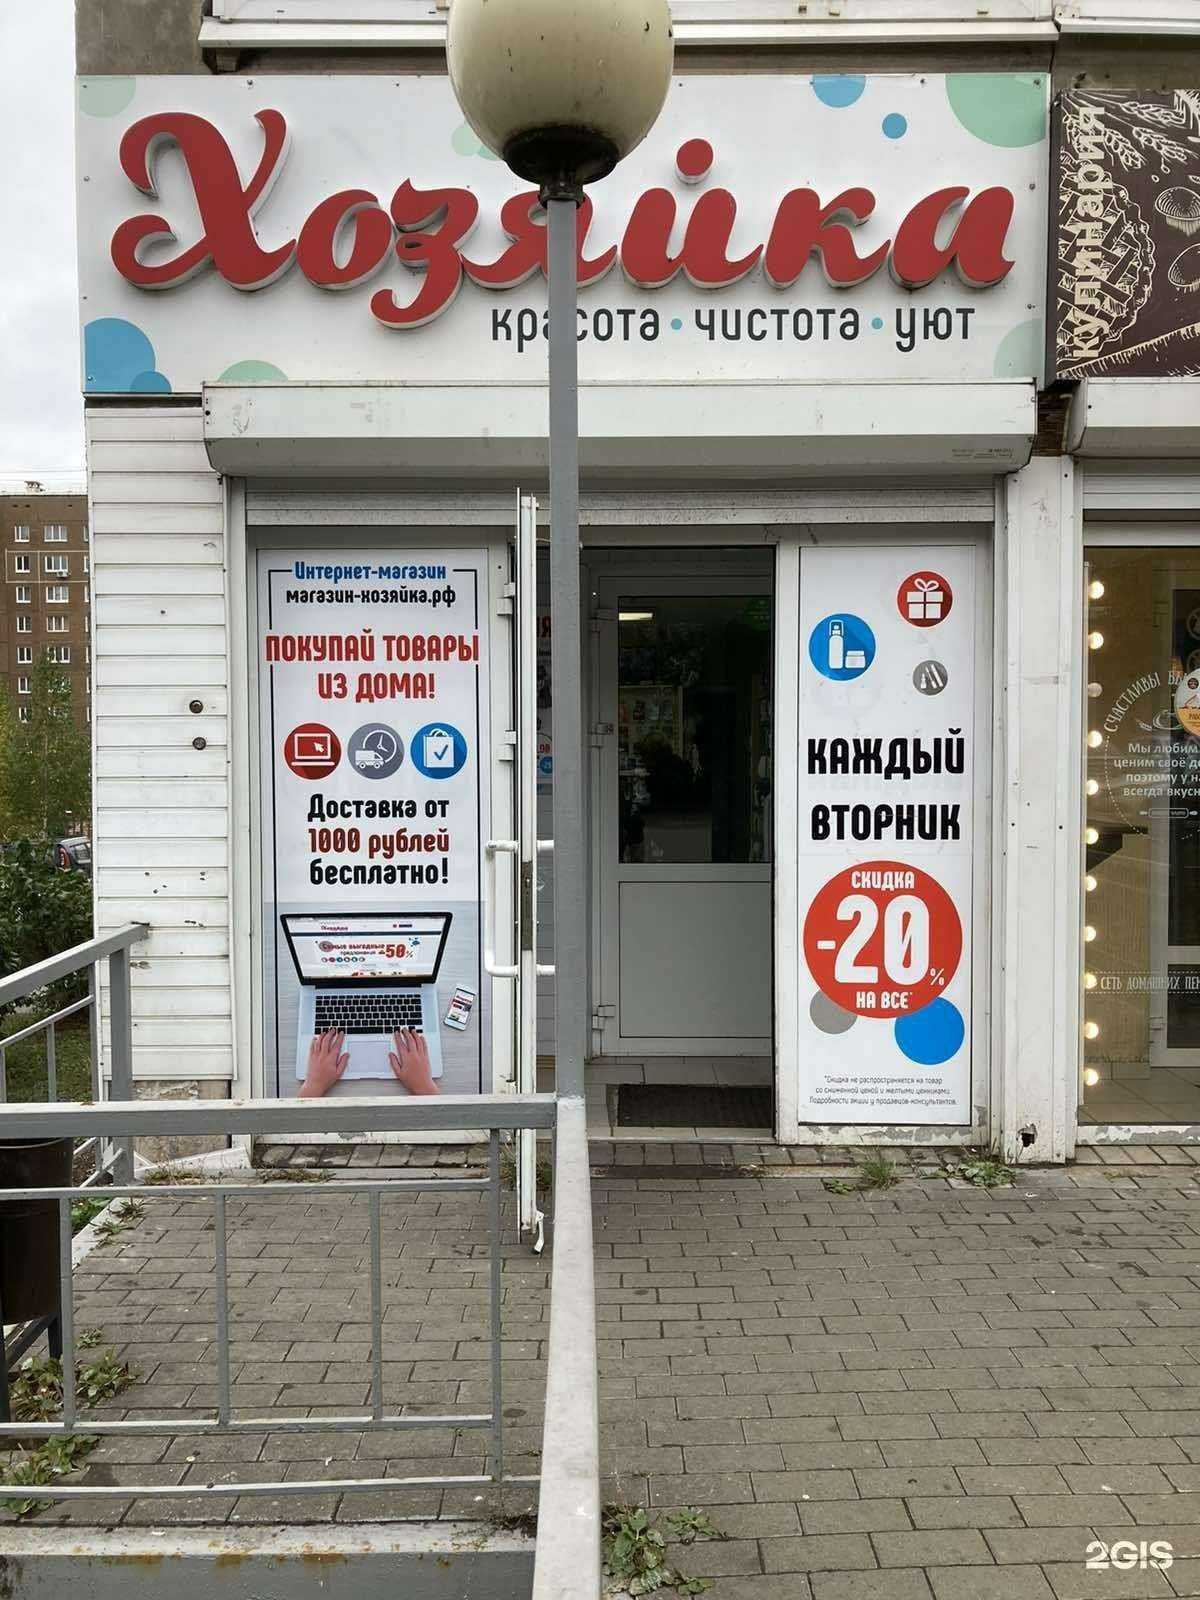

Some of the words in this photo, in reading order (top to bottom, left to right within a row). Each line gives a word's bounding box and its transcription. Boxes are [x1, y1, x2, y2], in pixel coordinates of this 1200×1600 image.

[112, 108, 1015, 328] Хозяйка
[695, 308, 860, 341] чистота
[895, 308, 976, 353] уют
[294, 561, 447, 582] Интернет-магазин
[286, 585, 457, 608] магазин-хозяйка.рф
[266, 628, 375, 662] ПОКУПАЙ
[382, 634, 479, 662] ТОВАРЫ
[317, 674, 348, 700] ИЗ
[355, 673, 436, 703] ДОМА!
[807, 727, 965, 780] КАЖДЫЙ
[1128, 743, 1151, 753] Мы
[1154, 742, 1199, 753] любим
[1114, 759, 1155, 769] ценим
[1158, 757, 1186, 767] своё
[1126, 774, 1178, 785] поэтому
[1180, 774, 1188, 785] у
[1123, 788, 1163, 799] всегда
[307, 793, 417, 822] Доставка
[424, 799, 450, 819] от
[811, 803, 961, 841] ВТОРНИК
[308, 827, 360, 852] 1000
[368, 827, 450, 859] рублей
[310, 857, 449, 885] бесплатно!
[851, 871, 915, 891] СКИДКА
[1100, 976, 1123, 990] СЕТЬ
[856, 991, 877, 1009] НА
